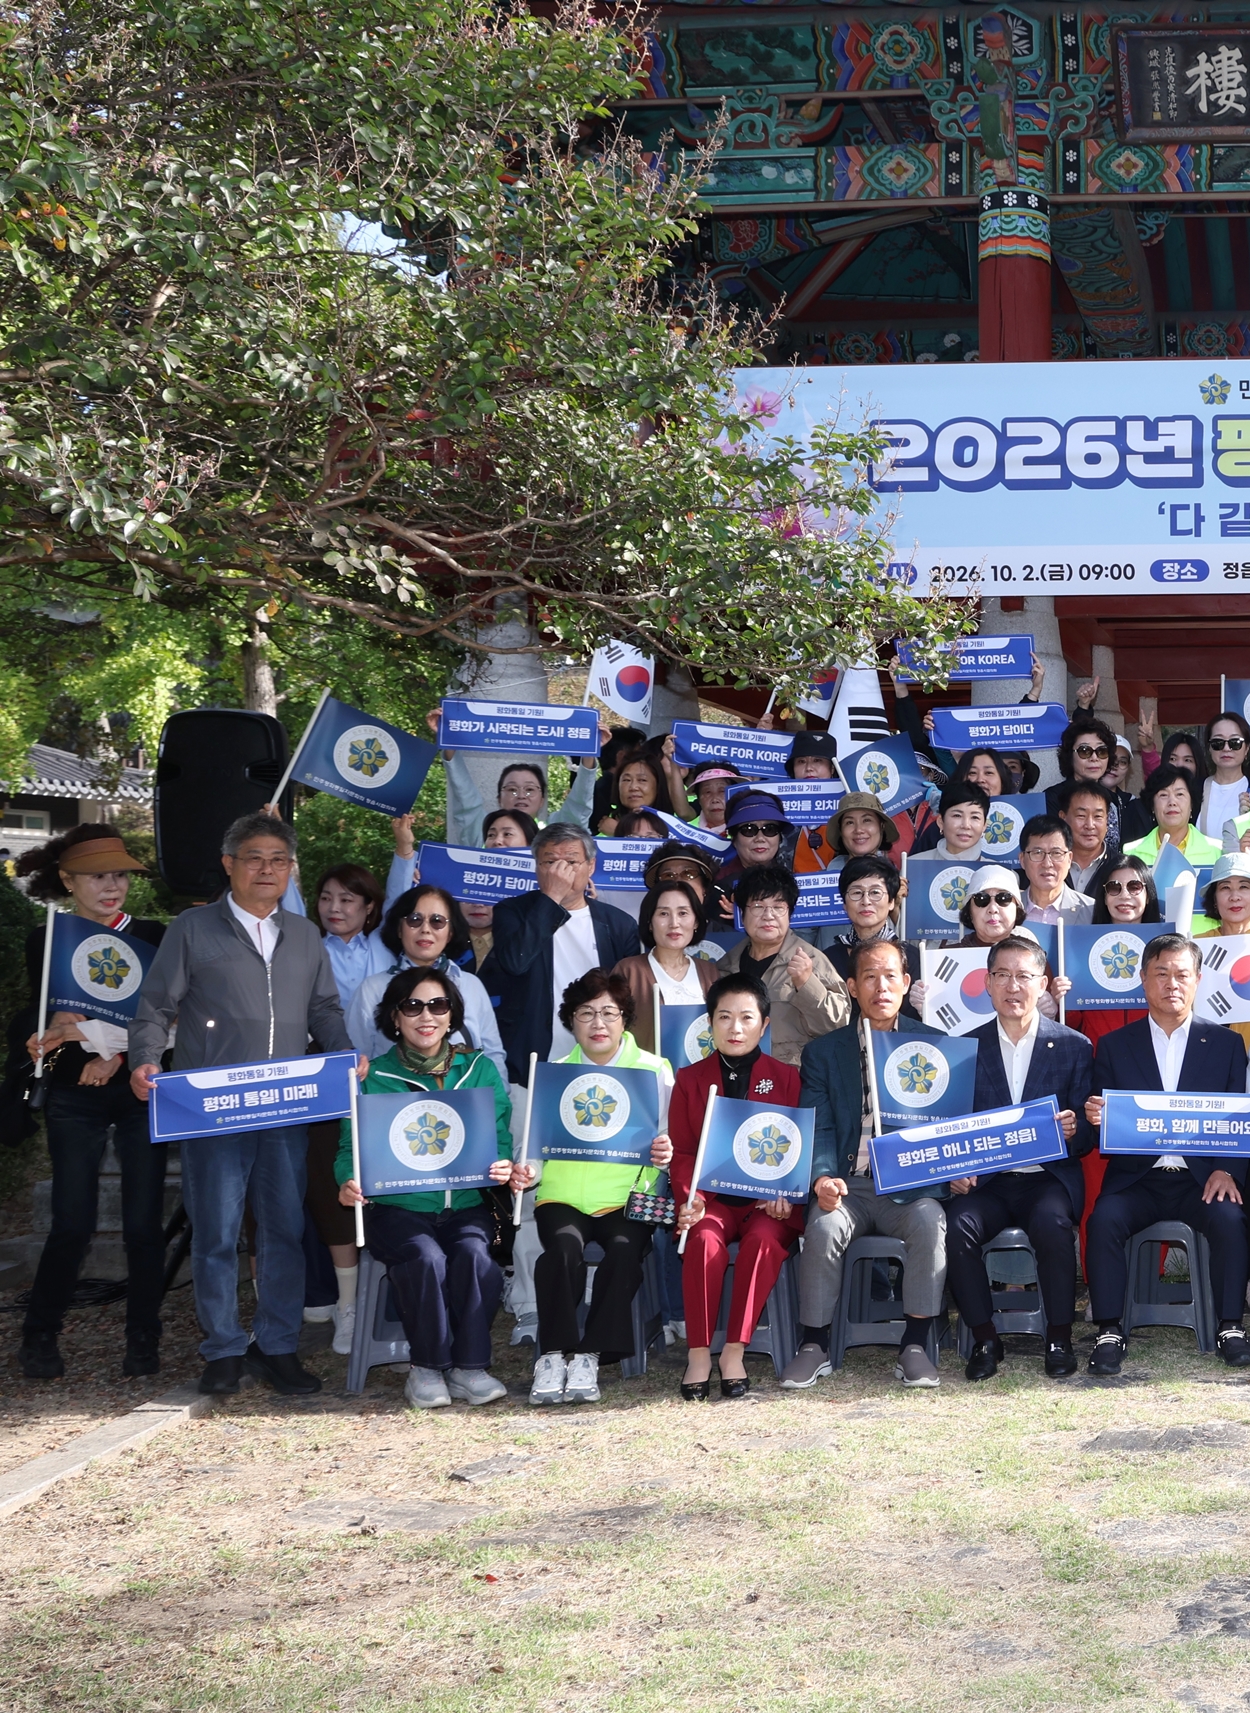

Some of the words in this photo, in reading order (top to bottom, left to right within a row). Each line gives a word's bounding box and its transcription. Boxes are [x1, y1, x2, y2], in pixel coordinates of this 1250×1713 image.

[870, 418, 1198, 486] 2026년
[930, 565, 985, 582] 2026.
[991, 564, 1017, 581] 10.
[1079, 563, 1136, 581] 09:00
[1162, 562, 1199, 581] 장소
[959, 655, 976, 665] OR
[977, 654, 1015, 665] KOREA
[497, 706, 526, 716] 평화통일
[527, 708, 544, 717] 기원!
[978, 710, 1005, 718] 평화통일
[1005, 709, 1021, 717] 기원!
[448, 720, 485, 733] 평화가
[487, 722, 535, 736] 시작되는
[537, 725, 564, 738] 도시!
[567, 727, 591, 739] 정읍
[723, 730, 750, 740] 평화통일
[751, 733, 767, 742] 기원!
[968, 725, 1000, 737] 평화가
[1002, 724, 1034, 736] 답이다
[690, 742, 728, 757] PEACE
[730, 746, 754, 760] FOR
[756, 750, 788, 764] KORE
[777, 784, 804, 793] 평화통일
[805, 784, 822, 792] 기원!
[782, 800, 812, 812] 평화를
[814, 799, 839, 811] 외치
[622, 843, 647, 852] 평화통일
[479, 854, 511, 867] 평화통일
[513, 859, 531, 869] 기원!
[603, 859, 626, 872] 평화!
[463, 870, 502, 888] 평화가
[797, 877, 820, 888] 화통일
[822, 876, 838, 885] 기원!
[795, 894, 831, 908] 작되는
[227, 1068, 265, 1083] 평화통일
[267, 1066, 289, 1077] 기원!
[202, 1094, 240, 1113] 평화!
[243, 1088, 280, 1107] 통일!
[282, 1084, 318, 1102] 미래!
[1169, 1099, 1203, 1109] 평화통일
[1205, 1100, 1225, 1109] 기원!
[935, 1121, 970, 1135] 평화통일
[971, 1117, 991, 1127] 기원!
[1136, 1117, 1168, 1135] 평화,
[1171, 1118, 1199, 1134] 함께
[897, 1148, 940, 1167] 평화로
[942, 1141, 971, 1158] 하나
[973, 1135, 1002, 1152] 되는
[1004, 1127, 1037, 1147] 정읍!
